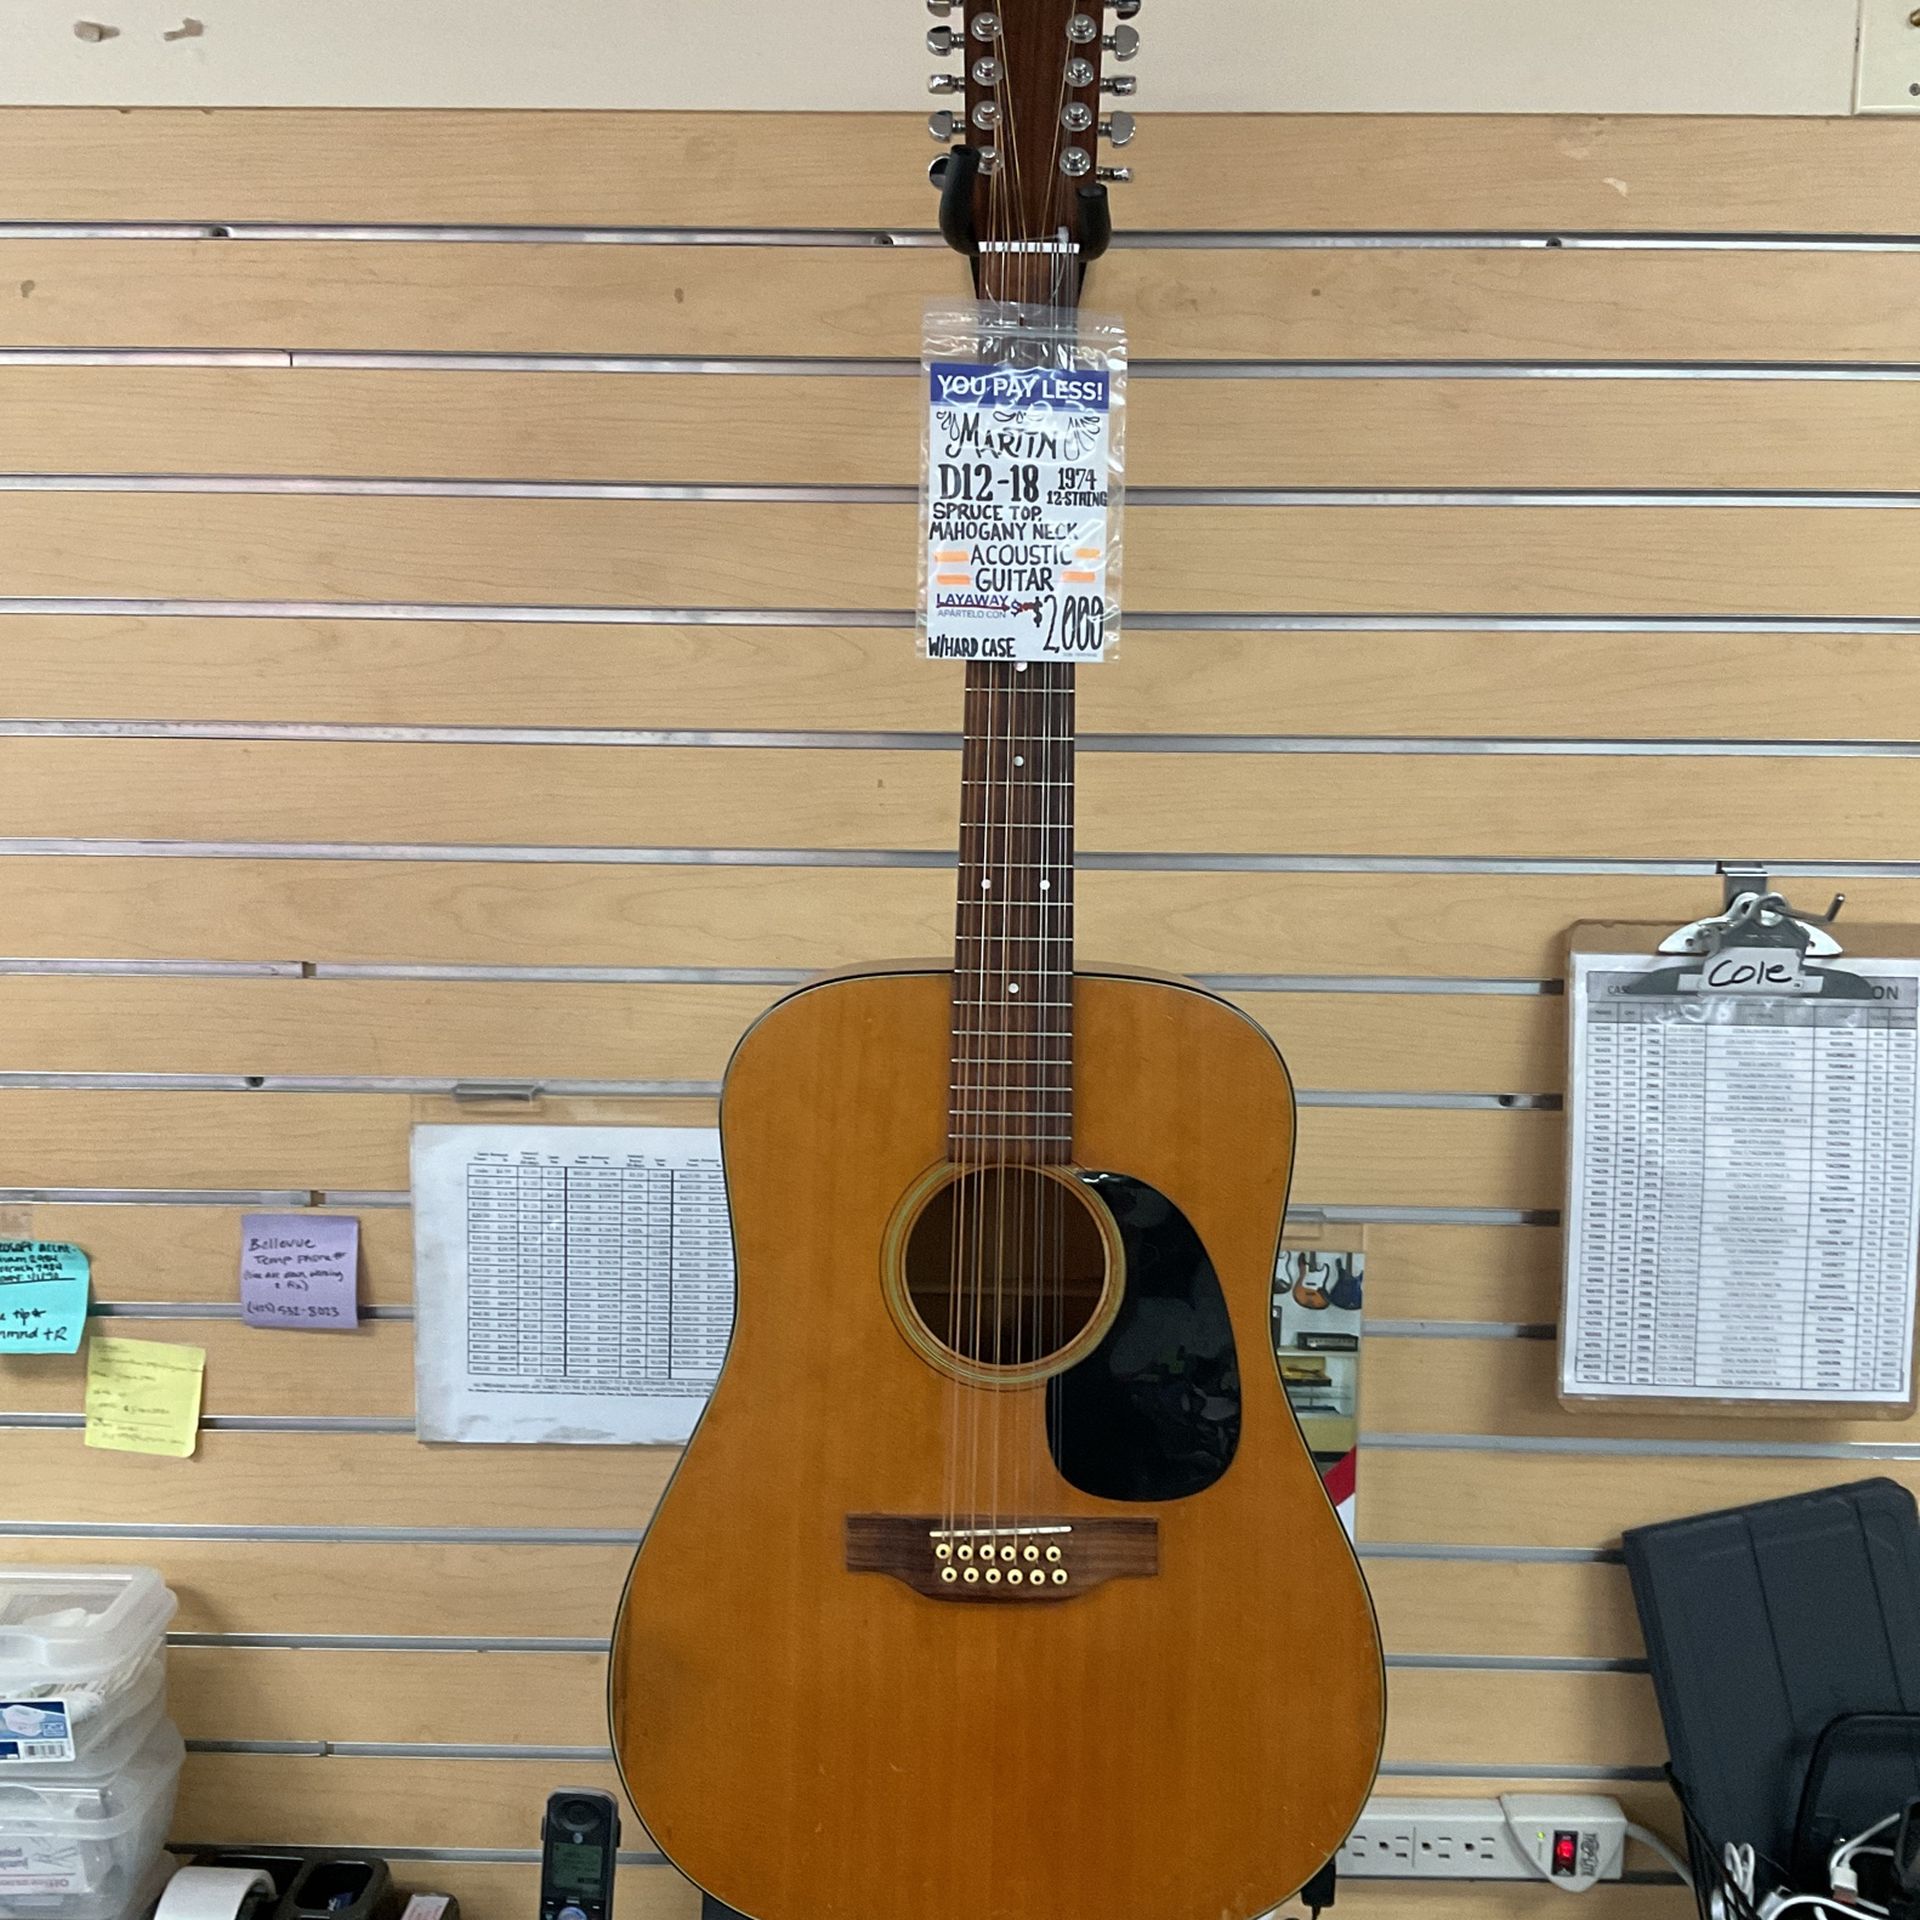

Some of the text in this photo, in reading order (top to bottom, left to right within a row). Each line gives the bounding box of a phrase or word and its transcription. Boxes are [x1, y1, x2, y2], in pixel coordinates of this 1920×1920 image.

[937, 374, 1103, 400] YOU PAY LESS!
[937, 463, 1040, 502] D12-18
[1057, 467, 1097, 490] 1974
[932, 502, 1003, 521] SPRUCE
[928, 521, 1079, 541] MAHOGANY NECK
[971, 544, 1073, 566] ACOUSTIC
[976, 567, 1055, 592] GUITAR
[936, 593, 1009, 607] LAYAWAY
[985, 610, 1007, 619] CON
[928, 634, 1016, 658] W/HARD CASE
[248, 1238, 316, 1252] Bellevue
